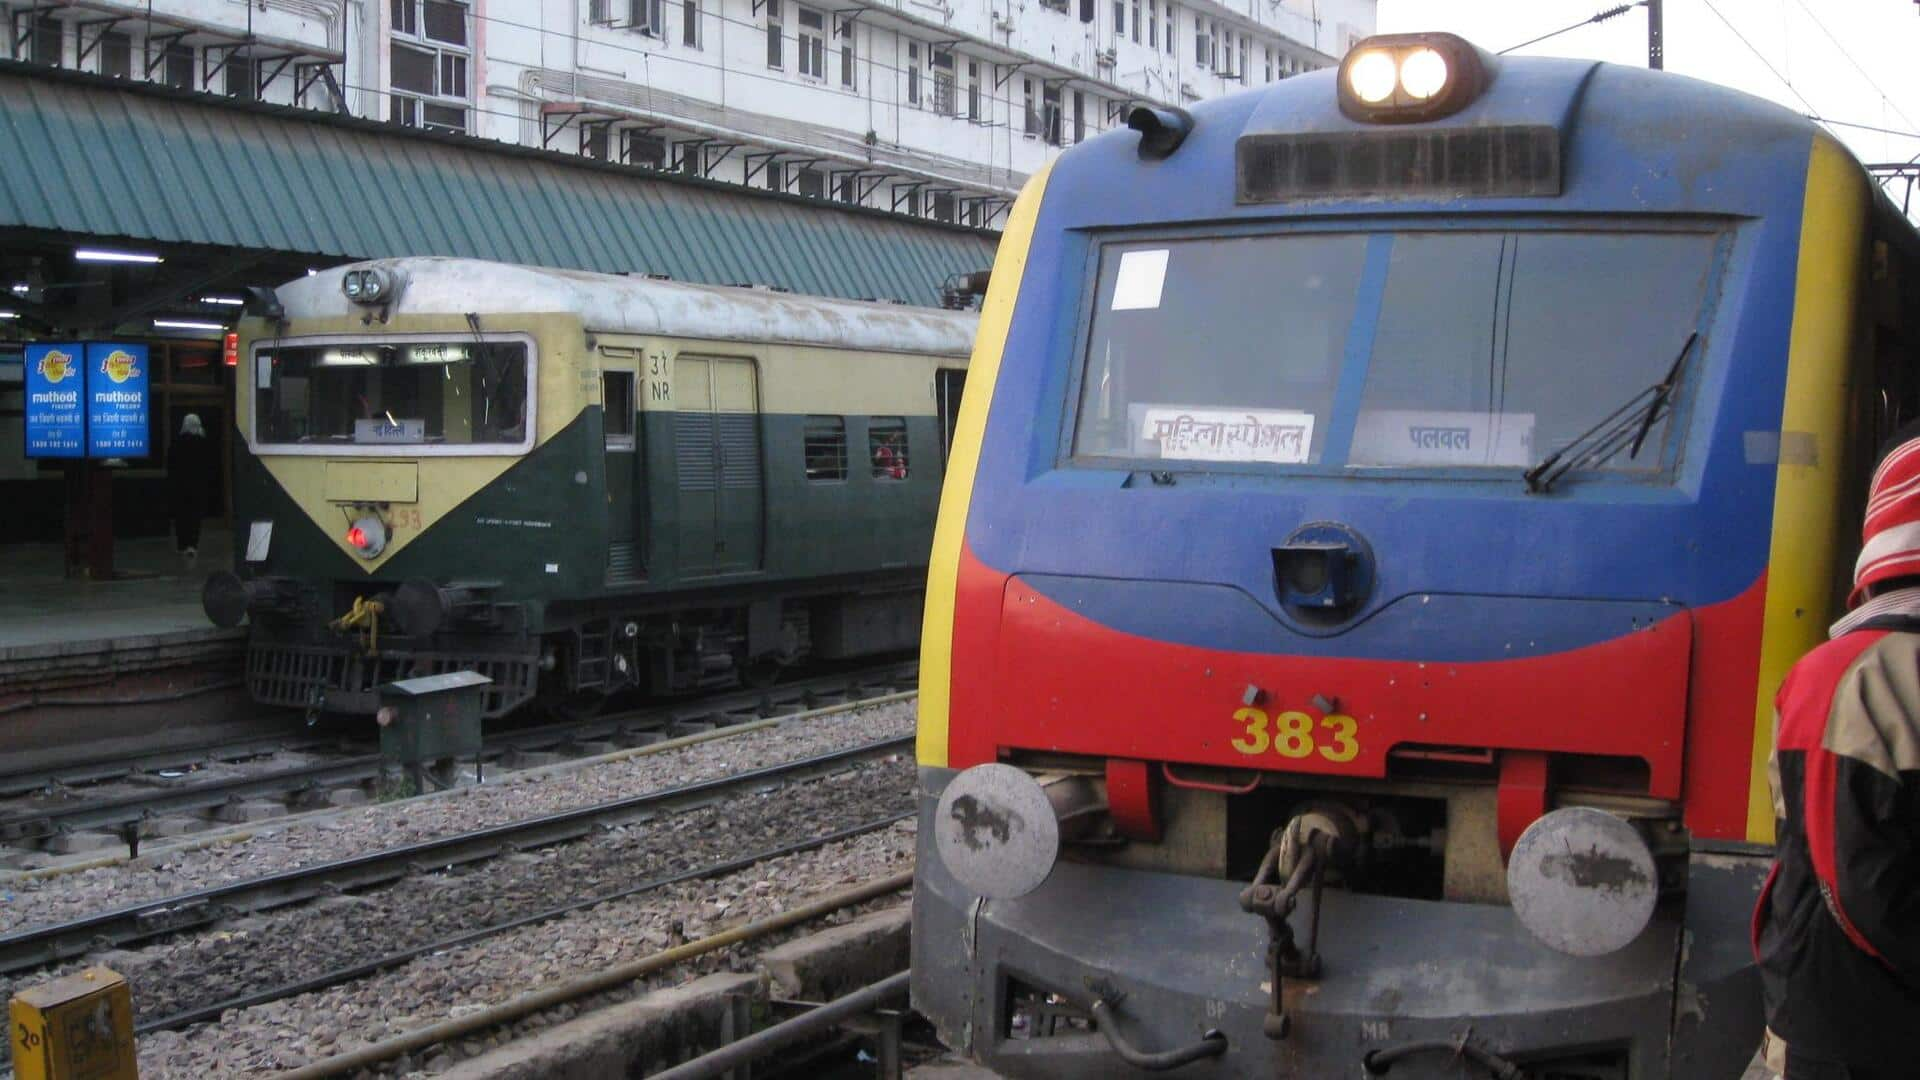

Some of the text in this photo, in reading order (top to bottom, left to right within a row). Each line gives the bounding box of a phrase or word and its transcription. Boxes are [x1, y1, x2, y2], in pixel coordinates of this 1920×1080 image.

[32, 391, 77, 403] muthoot
[96, 391, 141, 403] muthoot
[651, 381, 670, 401] NR
[1409, 426, 1470, 450] पलवल
[1231, 706, 1360, 763] 383
[1206, 1000, 1228, 1020] BP
[1361, 1020, 1390, 1041] MR
